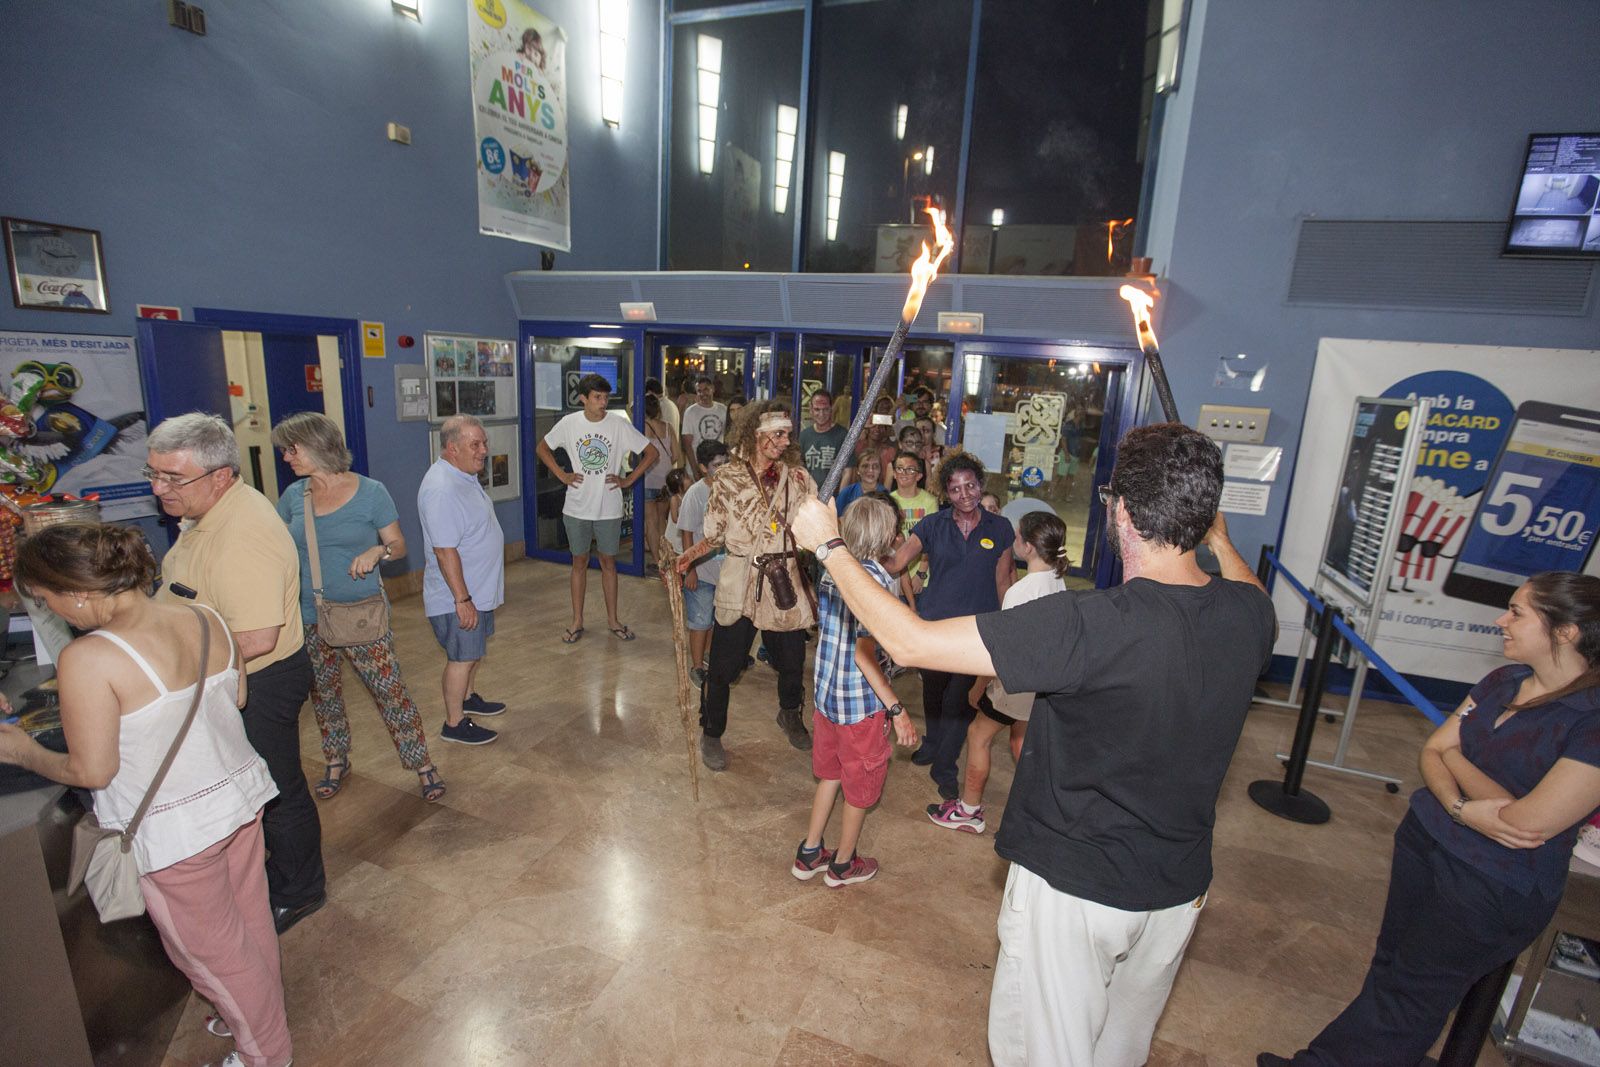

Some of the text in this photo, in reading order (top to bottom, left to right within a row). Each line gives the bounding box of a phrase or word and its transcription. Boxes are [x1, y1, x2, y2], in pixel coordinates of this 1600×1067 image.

[515, 61, 533, 78] PER
[501, 64, 546, 99] MOLTS
[488, 78, 555, 130] ANYS
[485, 148, 501, 164] 8€
[71, 339, 131, 350] DESITJADA
[1456, 395, 1475, 411] la
[1427, 413, 1501, 431] ACARD
[1423, 430, 1470, 444] mpra
[1418, 446, 1489, 472] ine a
[1527, 535, 1584, 551] per entrada
[1403, 613, 1454, 629] compra
[1455, 620, 1465, 631] a
